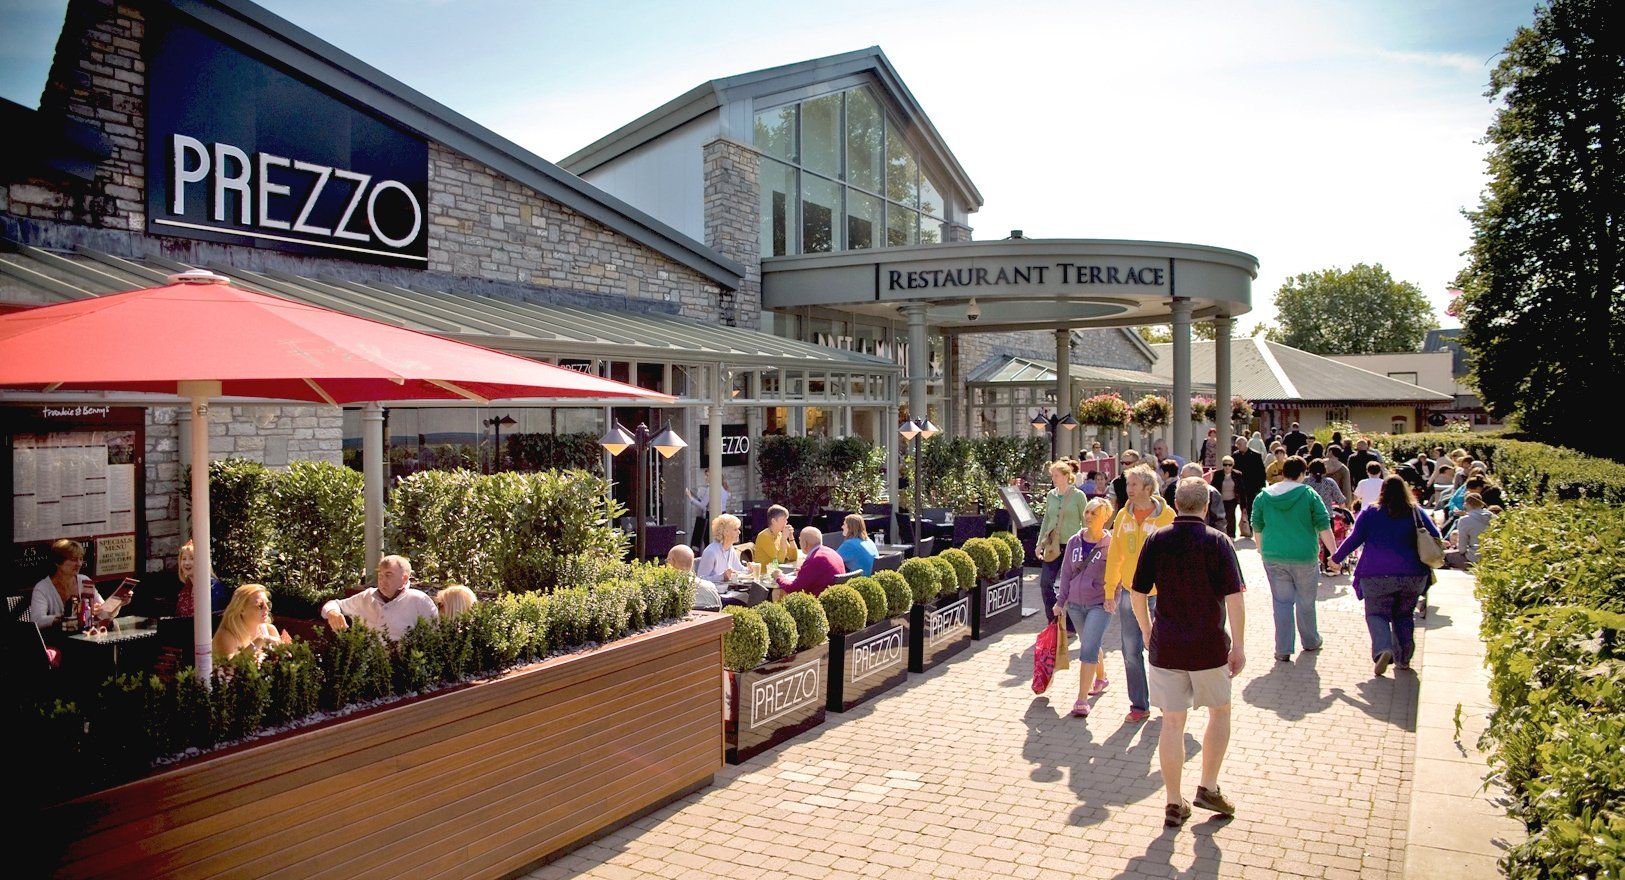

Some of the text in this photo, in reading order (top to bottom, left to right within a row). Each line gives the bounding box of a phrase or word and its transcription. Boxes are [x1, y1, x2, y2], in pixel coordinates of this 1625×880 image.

[172, 133, 422, 248] PREZZO
[888, 262, 1165, 291] RESTAURANT TERRACE
[720, 435, 750, 455] EZZO
[988, 581, 1018, 613] PREZZO
[931, 603, 967, 641] PREZZO
[854, 633, 901, 676] PREZZO
[755, 668, 817, 720] PREZZO
